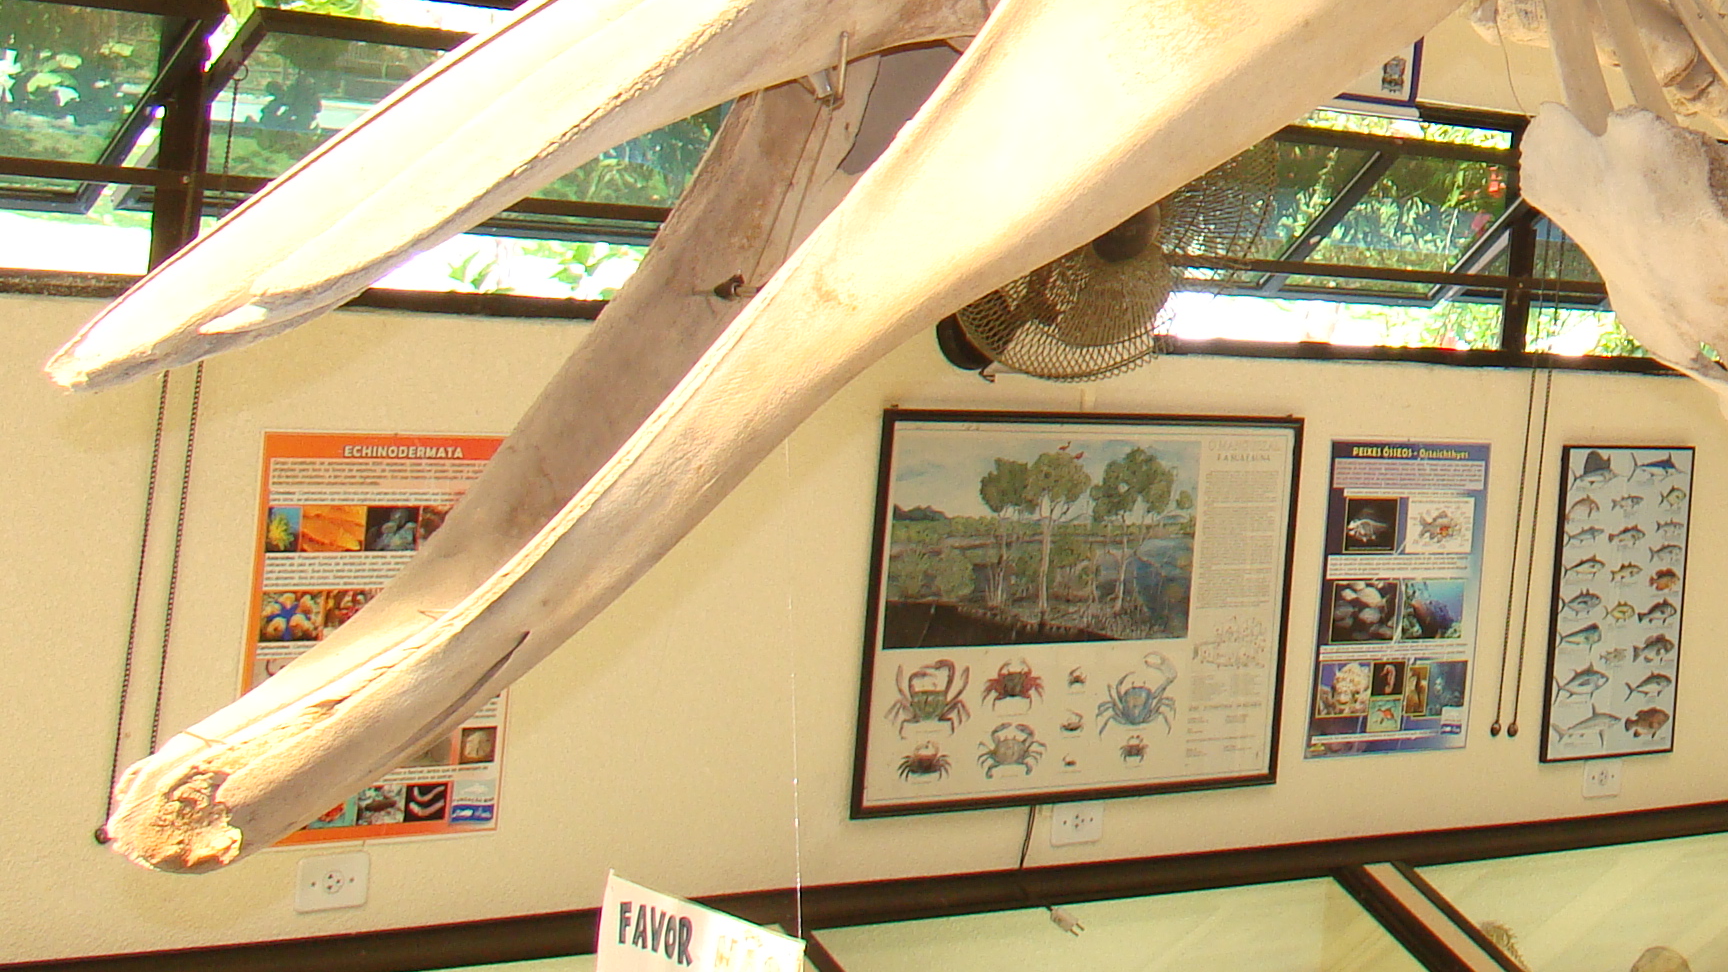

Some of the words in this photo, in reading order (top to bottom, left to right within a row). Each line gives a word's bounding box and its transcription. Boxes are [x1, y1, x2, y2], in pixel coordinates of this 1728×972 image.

[343, 444, 464, 459] ECHINODERMATA
[1352, 446, 1380, 457] PEIXES
[618, 901, 694, 968] FAVOR
